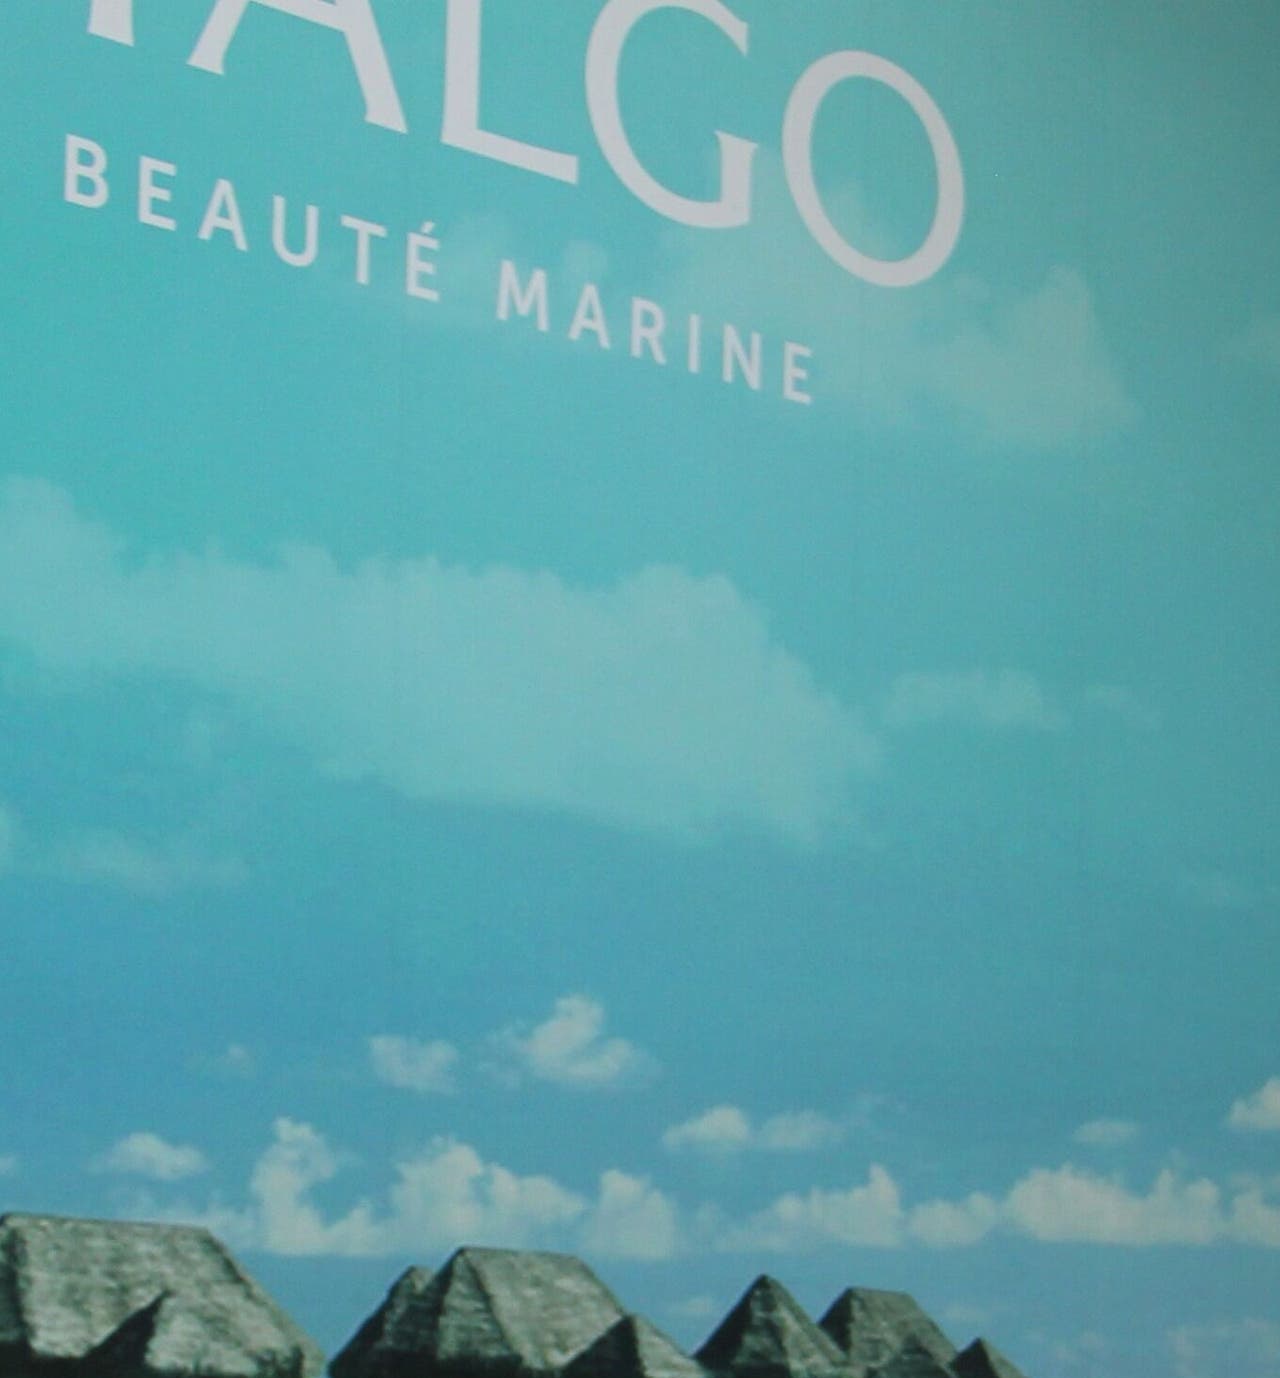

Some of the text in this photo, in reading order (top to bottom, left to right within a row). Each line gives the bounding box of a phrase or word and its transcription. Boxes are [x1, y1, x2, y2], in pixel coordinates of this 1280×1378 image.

[63, 133, 813, 405] BEAUTÉ MARINE
[86, 0, 964, 288] ALGO
